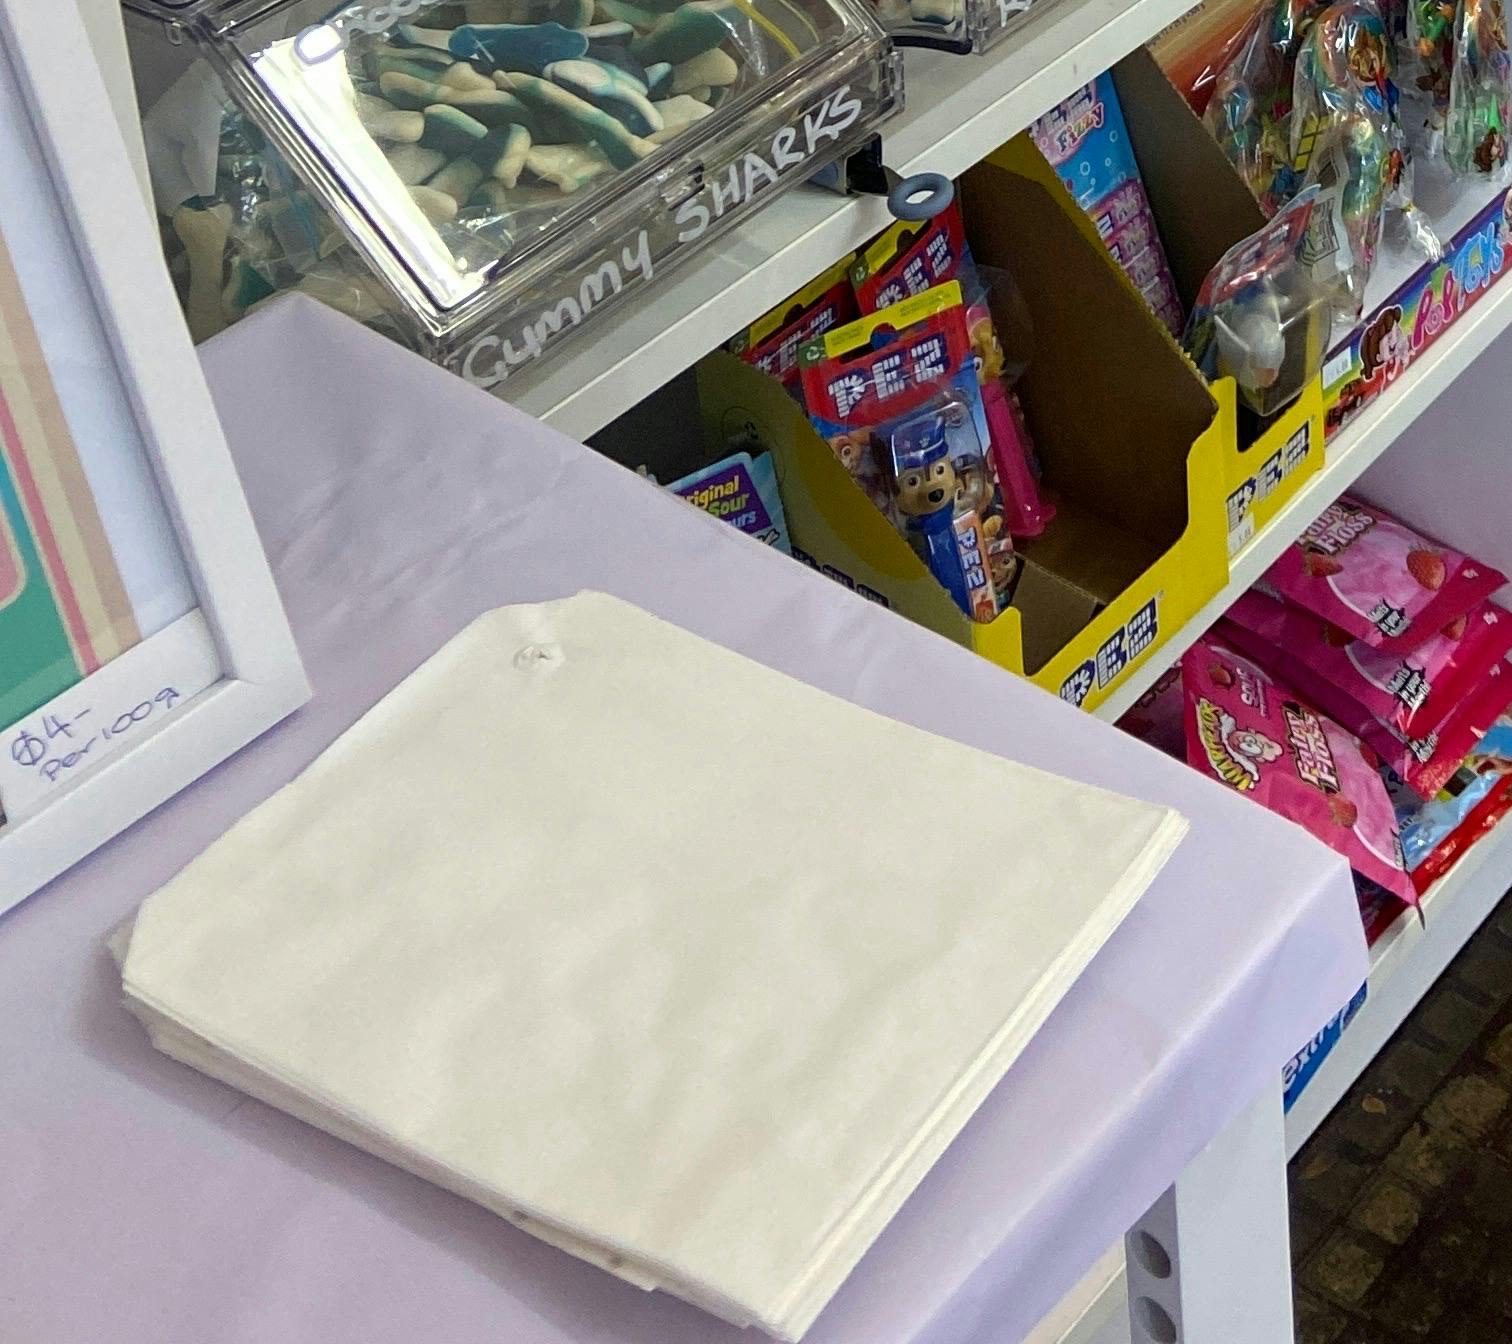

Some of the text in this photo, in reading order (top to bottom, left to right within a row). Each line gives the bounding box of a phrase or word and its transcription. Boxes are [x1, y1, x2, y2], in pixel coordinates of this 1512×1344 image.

[675, 83, 863, 244] SHARKS
[1056, 101, 1104, 155] Fizzy
[875, 232, 954, 309] PEZ
[828, 336, 946, 419] PEZ
[684, 474, 740, 509] riginal
[1225, 418, 1311, 519] PEZ
[954, 525, 986, 591] PEZ
[1319, 510, 1376, 554] Floss
[1060, 596, 1158, 708] PEZ
